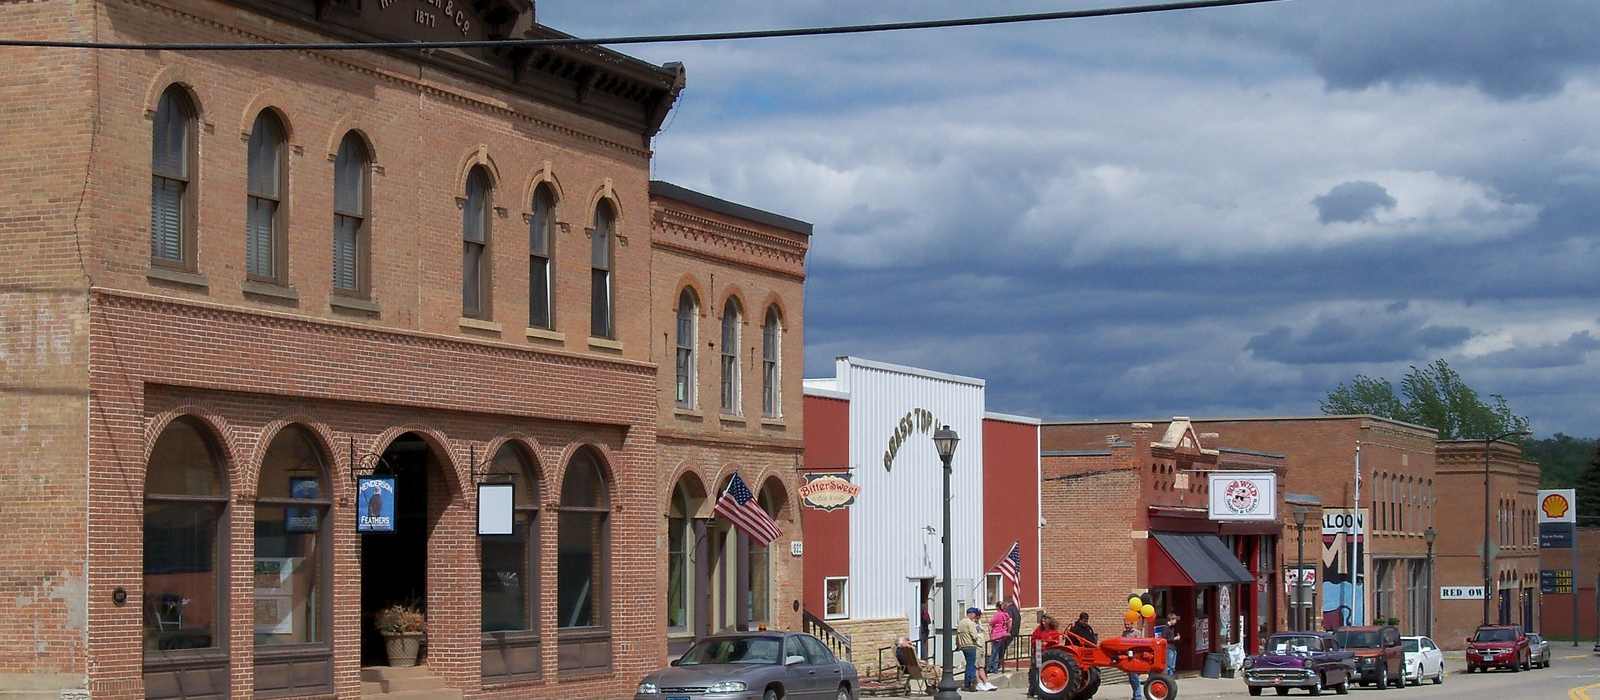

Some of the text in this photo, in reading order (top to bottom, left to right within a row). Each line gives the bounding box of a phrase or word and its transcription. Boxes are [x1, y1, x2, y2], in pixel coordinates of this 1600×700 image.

[445, 0, 453, 16] &
[416, 9, 436, 28] 1877
[884, 411, 913, 473] BRASS
[914, 408, 933, 436] TOP
[1226, 480, 1257, 497] HOG WILD
[361, 516, 390, 524] FEATHERS
[1442, 589, 1463, 597] RED
